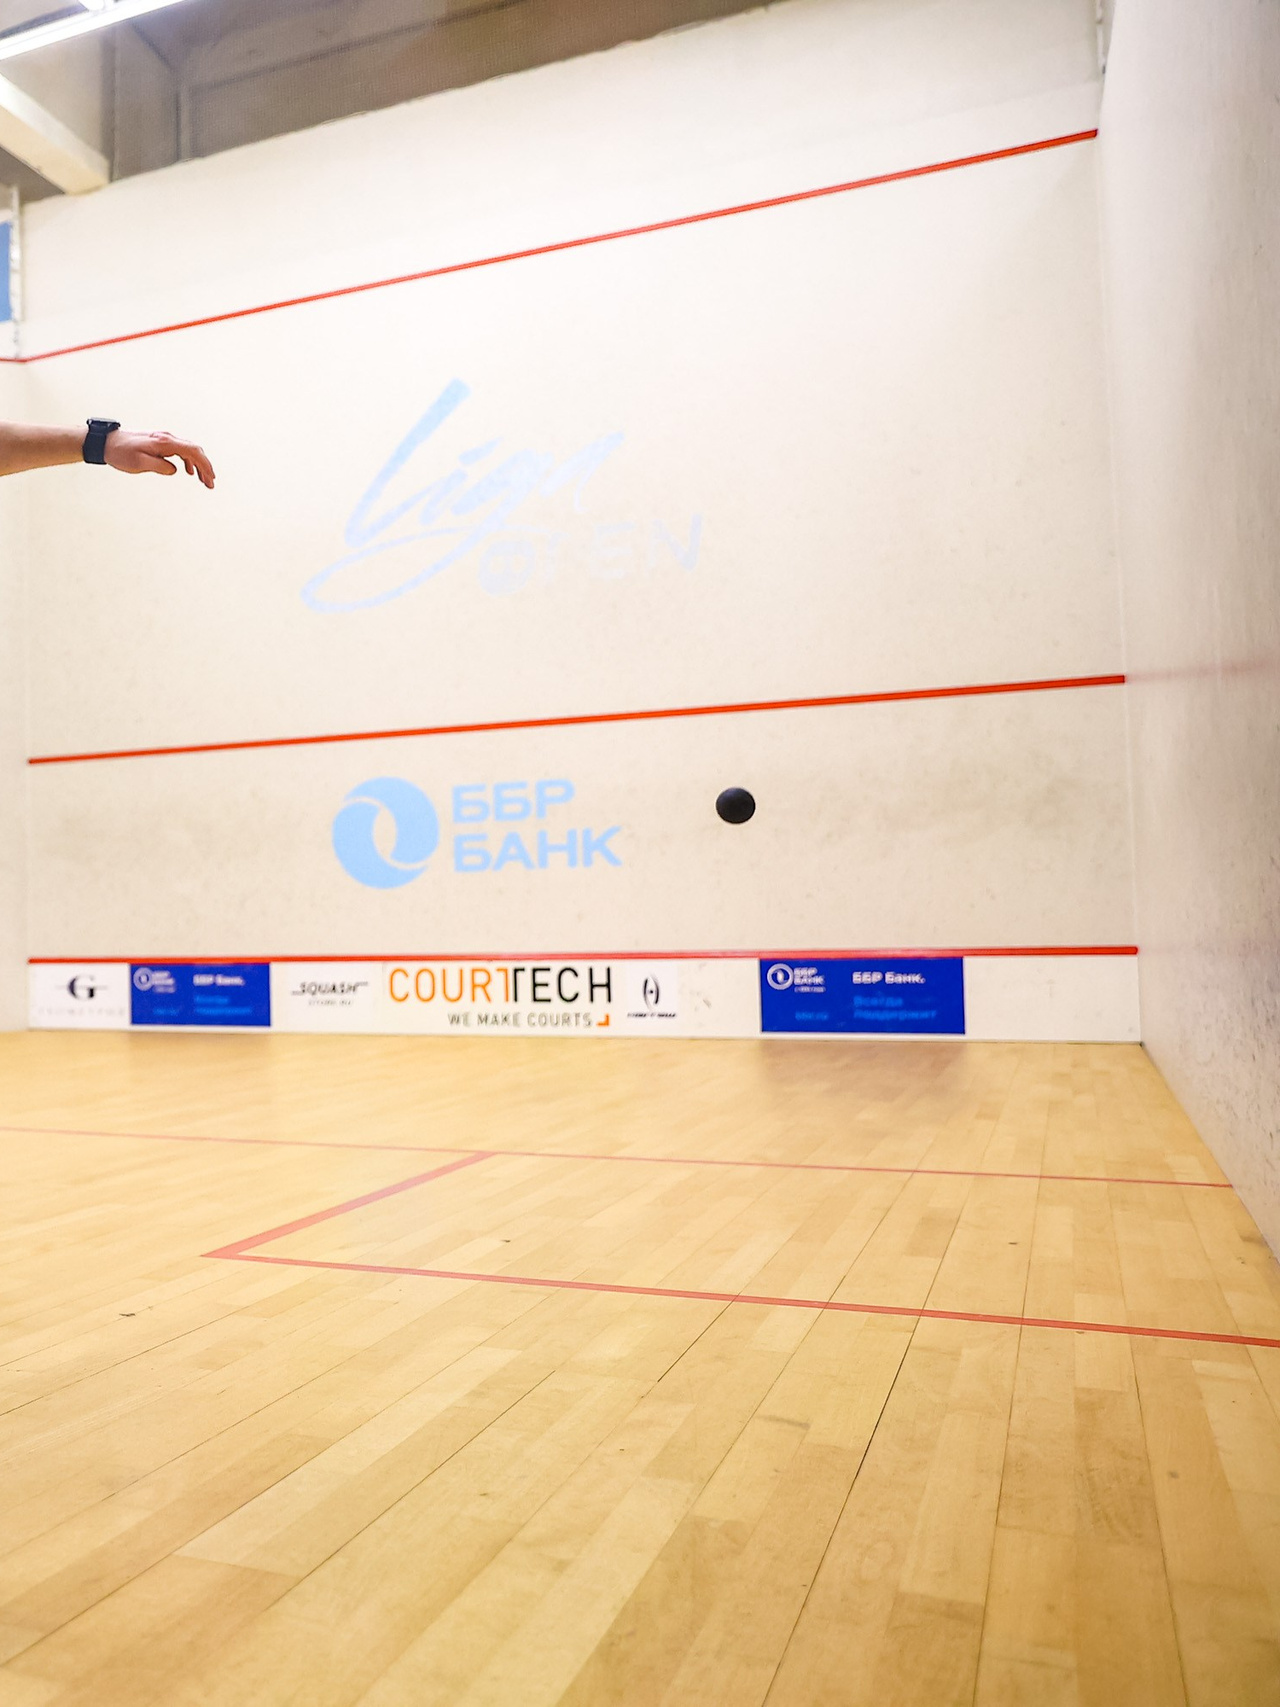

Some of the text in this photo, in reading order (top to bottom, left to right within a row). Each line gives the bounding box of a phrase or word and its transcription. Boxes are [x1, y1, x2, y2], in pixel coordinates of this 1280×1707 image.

[451, 778, 576, 824] ББР
[452, 825, 624, 874] БАНК
[67, 974, 96, 1001] G
[447, 1012, 592, 1027] WE MAKE COURTS
